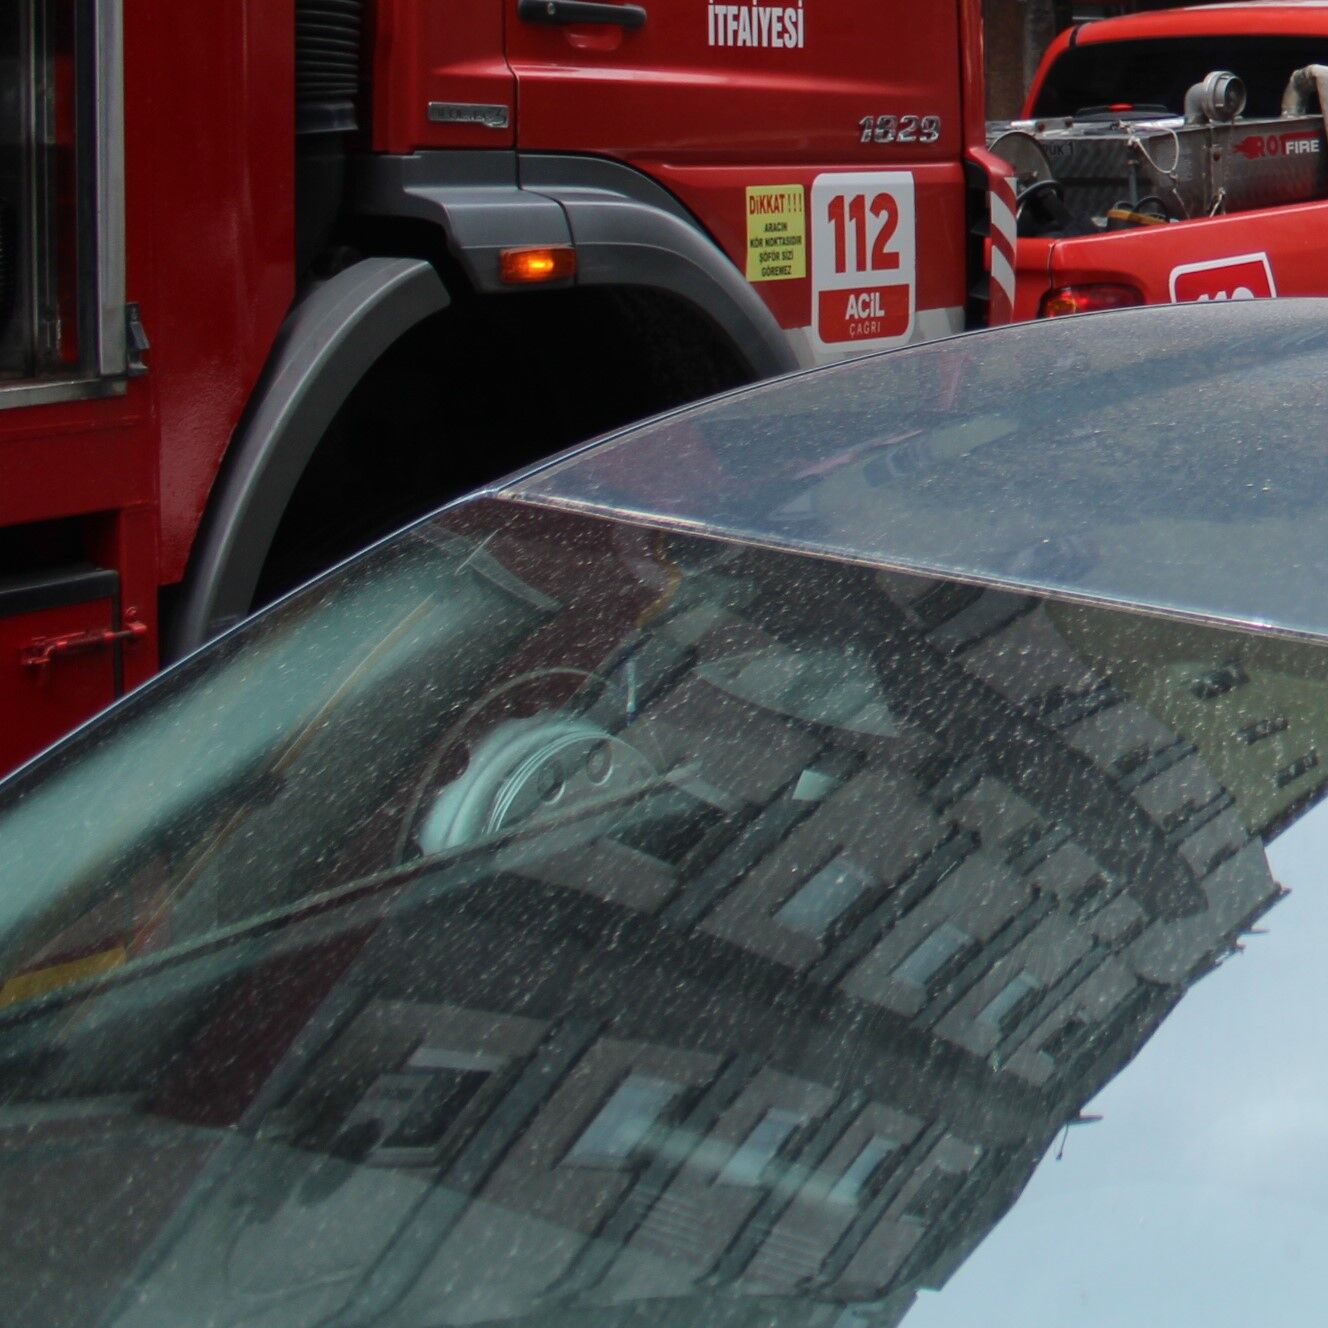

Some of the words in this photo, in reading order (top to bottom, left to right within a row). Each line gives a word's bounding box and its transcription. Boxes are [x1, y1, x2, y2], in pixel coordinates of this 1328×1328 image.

[859, 115, 941, 143] 1829
[1285, 139, 1320, 154] FIRE
[827, 192, 900, 274] 112
[849, 322, 881, 337] ÇAĞRI
